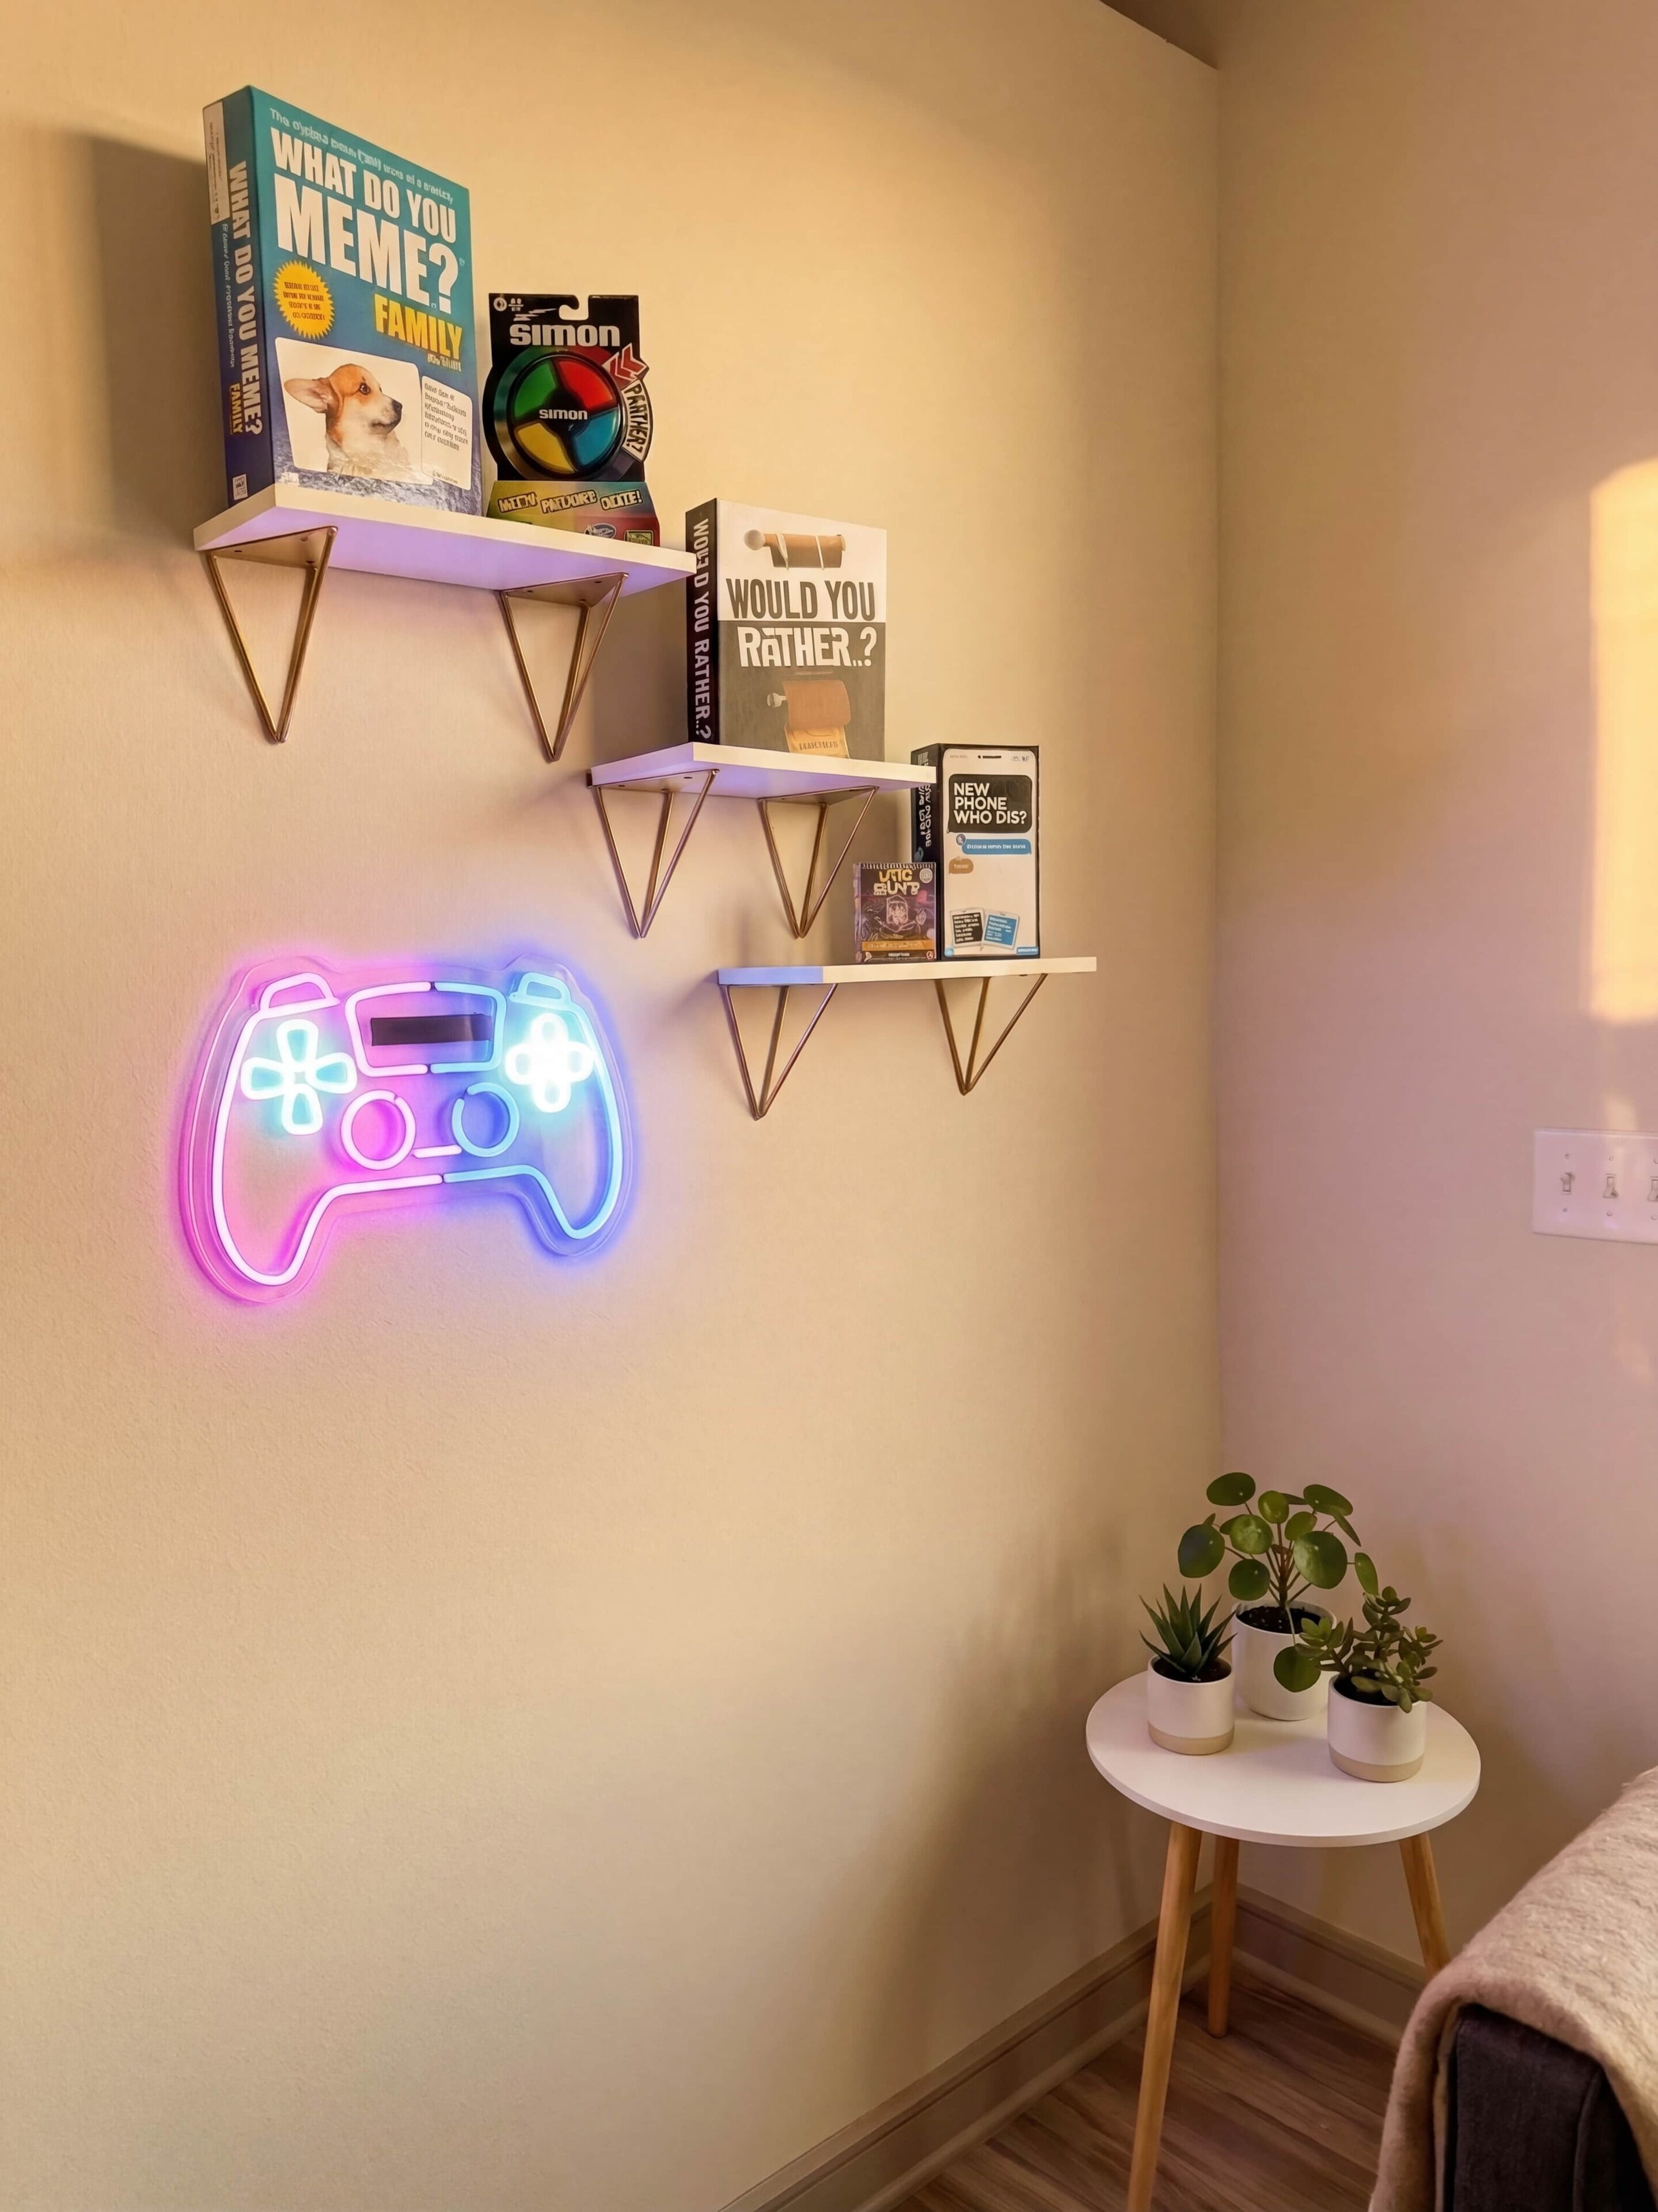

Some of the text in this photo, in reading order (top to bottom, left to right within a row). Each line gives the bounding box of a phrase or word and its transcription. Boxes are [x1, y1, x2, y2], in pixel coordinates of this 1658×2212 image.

[270, 127, 356, 200] WHAT
[363, 169, 400, 219] DO
[407, 189, 456, 244] YOU
[274, 173, 458, 314] MEME?
[230, 161, 263, 436] WHAT DO YOU MEME?
[374, 294, 462, 359] FAMILY
[229, 383, 244, 434] FAMILY
[695, 590, 709, 632] YOU
[726, 578, 875, 621] WOULD YOU
[954, 783, 989, 796] NEW
[955, 797, 1007, 810] PHONE
[954, 810, 1027, 824] WHO DIS?
